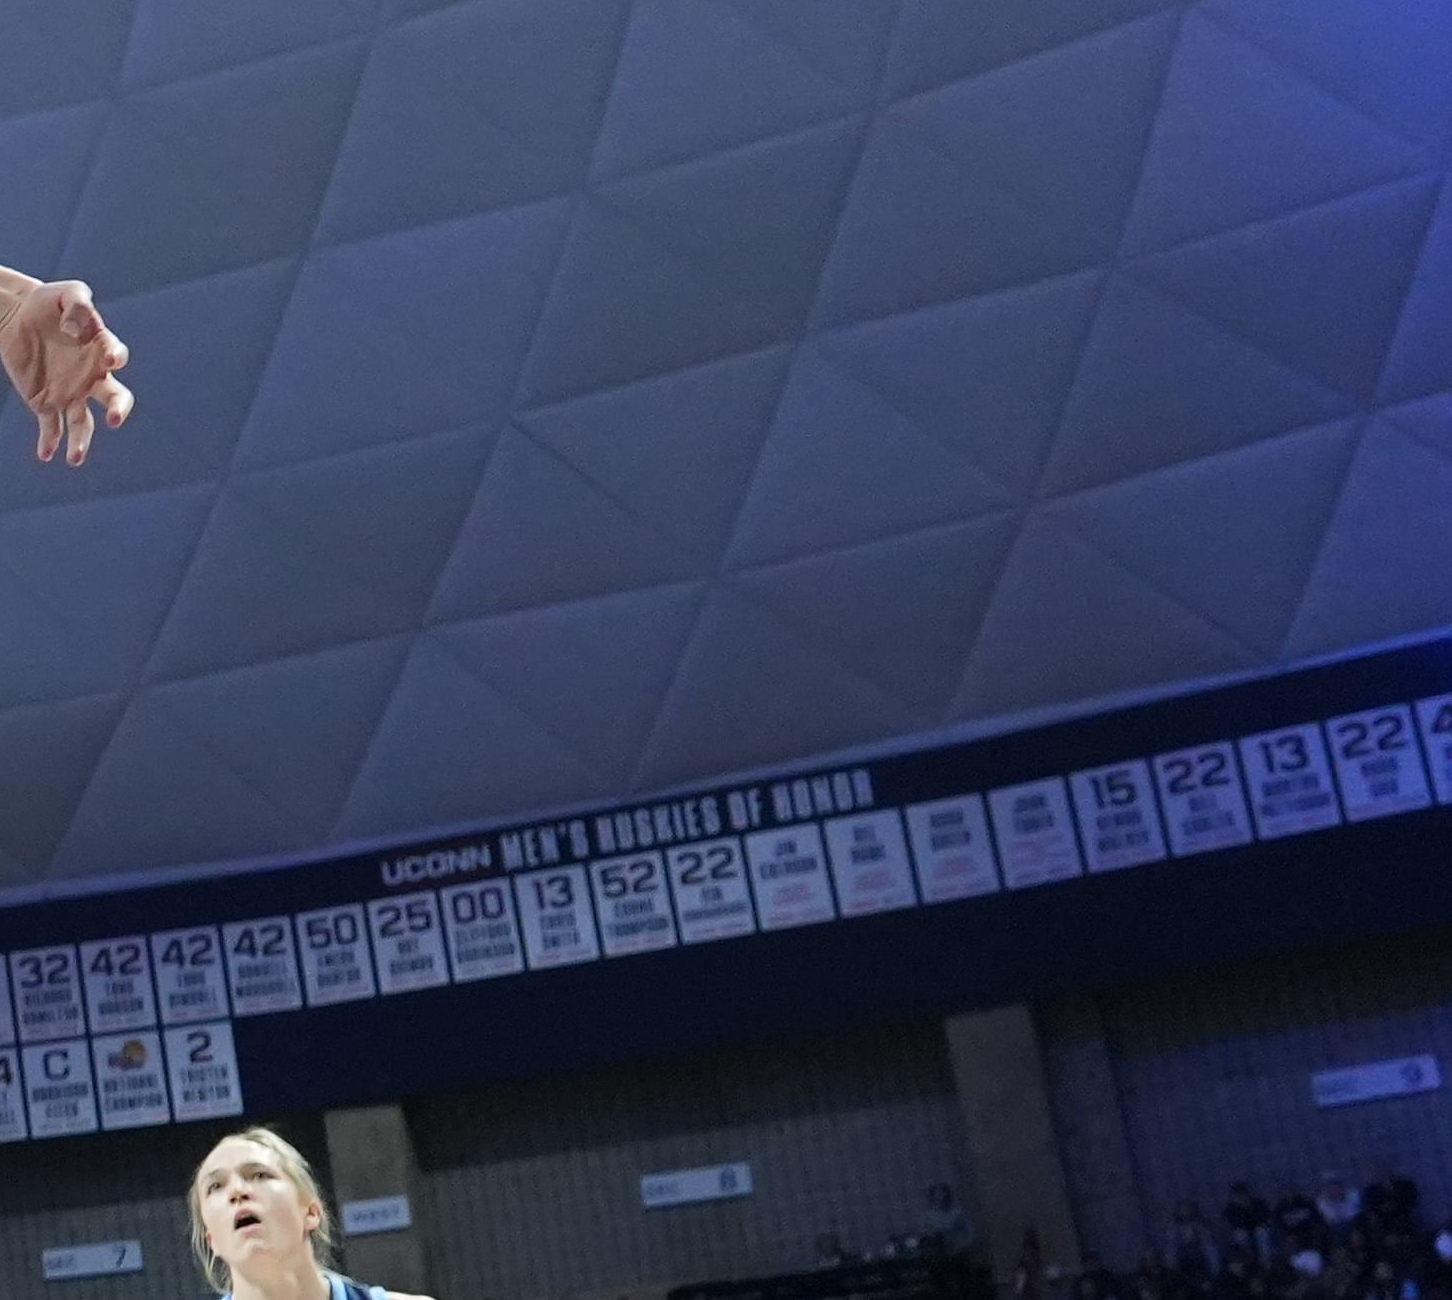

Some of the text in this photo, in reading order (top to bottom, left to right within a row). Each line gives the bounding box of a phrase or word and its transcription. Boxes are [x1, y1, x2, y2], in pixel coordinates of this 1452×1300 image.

[1090, 715, 1405, 808] 15 22 13 22
[381, 843, 492, 887] UCONN
[500, 818, 589, 871] MEN'S
[18, 953, 71, 990] 32
[90, 944, 144, 978] 42
[160, 934, 215, 968] 42
[233, 924, 287, 958] 42
[304, 913, 359, 951] 50
[375, 901, 433, 939] 25
[533, 875, 573, 911] 13
[601, 861, 660, 900] 52
[677, 845, 738, 885] 22
[186, 1031, 214, 1064] 2
